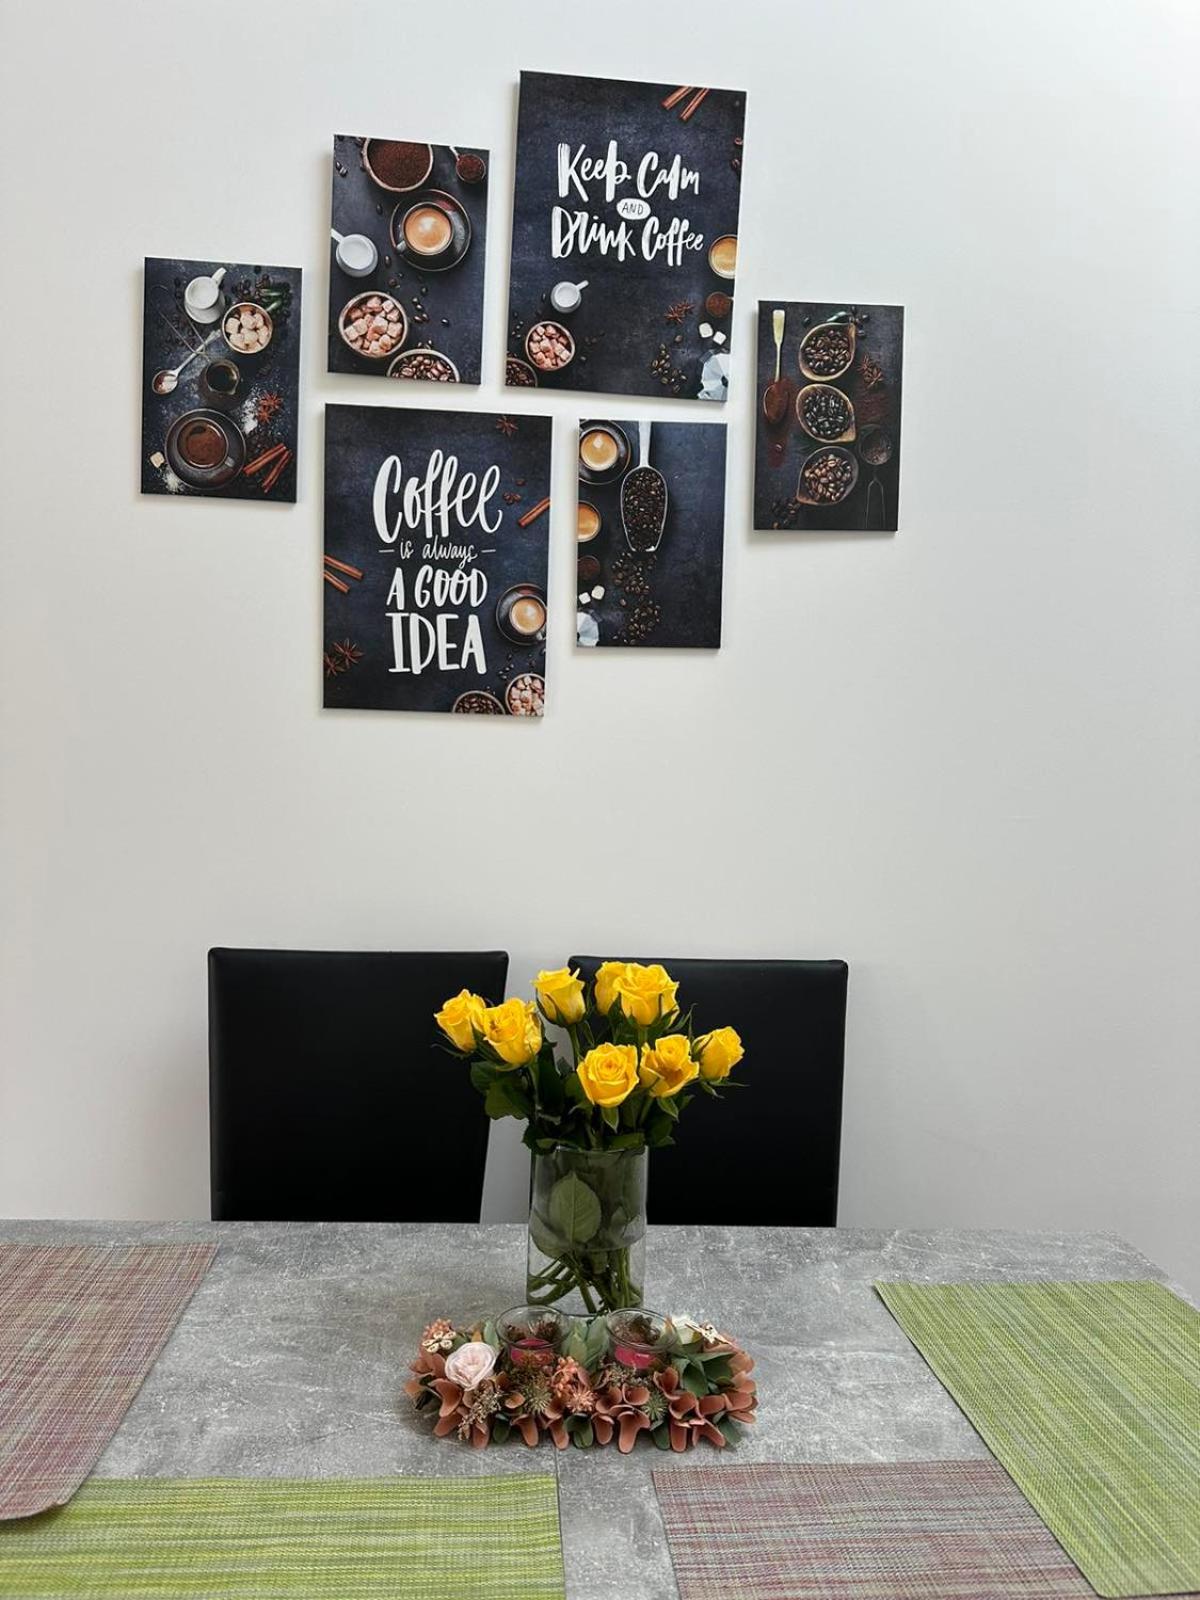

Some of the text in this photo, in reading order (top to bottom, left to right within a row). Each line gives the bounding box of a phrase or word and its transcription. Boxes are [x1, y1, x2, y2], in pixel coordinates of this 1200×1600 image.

[557, 139, 700, 203] Keep Calm
[551, 206, 704, 267] Drink Coffee
[620, 202, 645, 215] AND
[372, 449, 503, 544] Coffee
[400, 535, 478, 570] is always
[386, 564, 488, 611] A GOOD
[385, 612, 487, 675] IDEA
